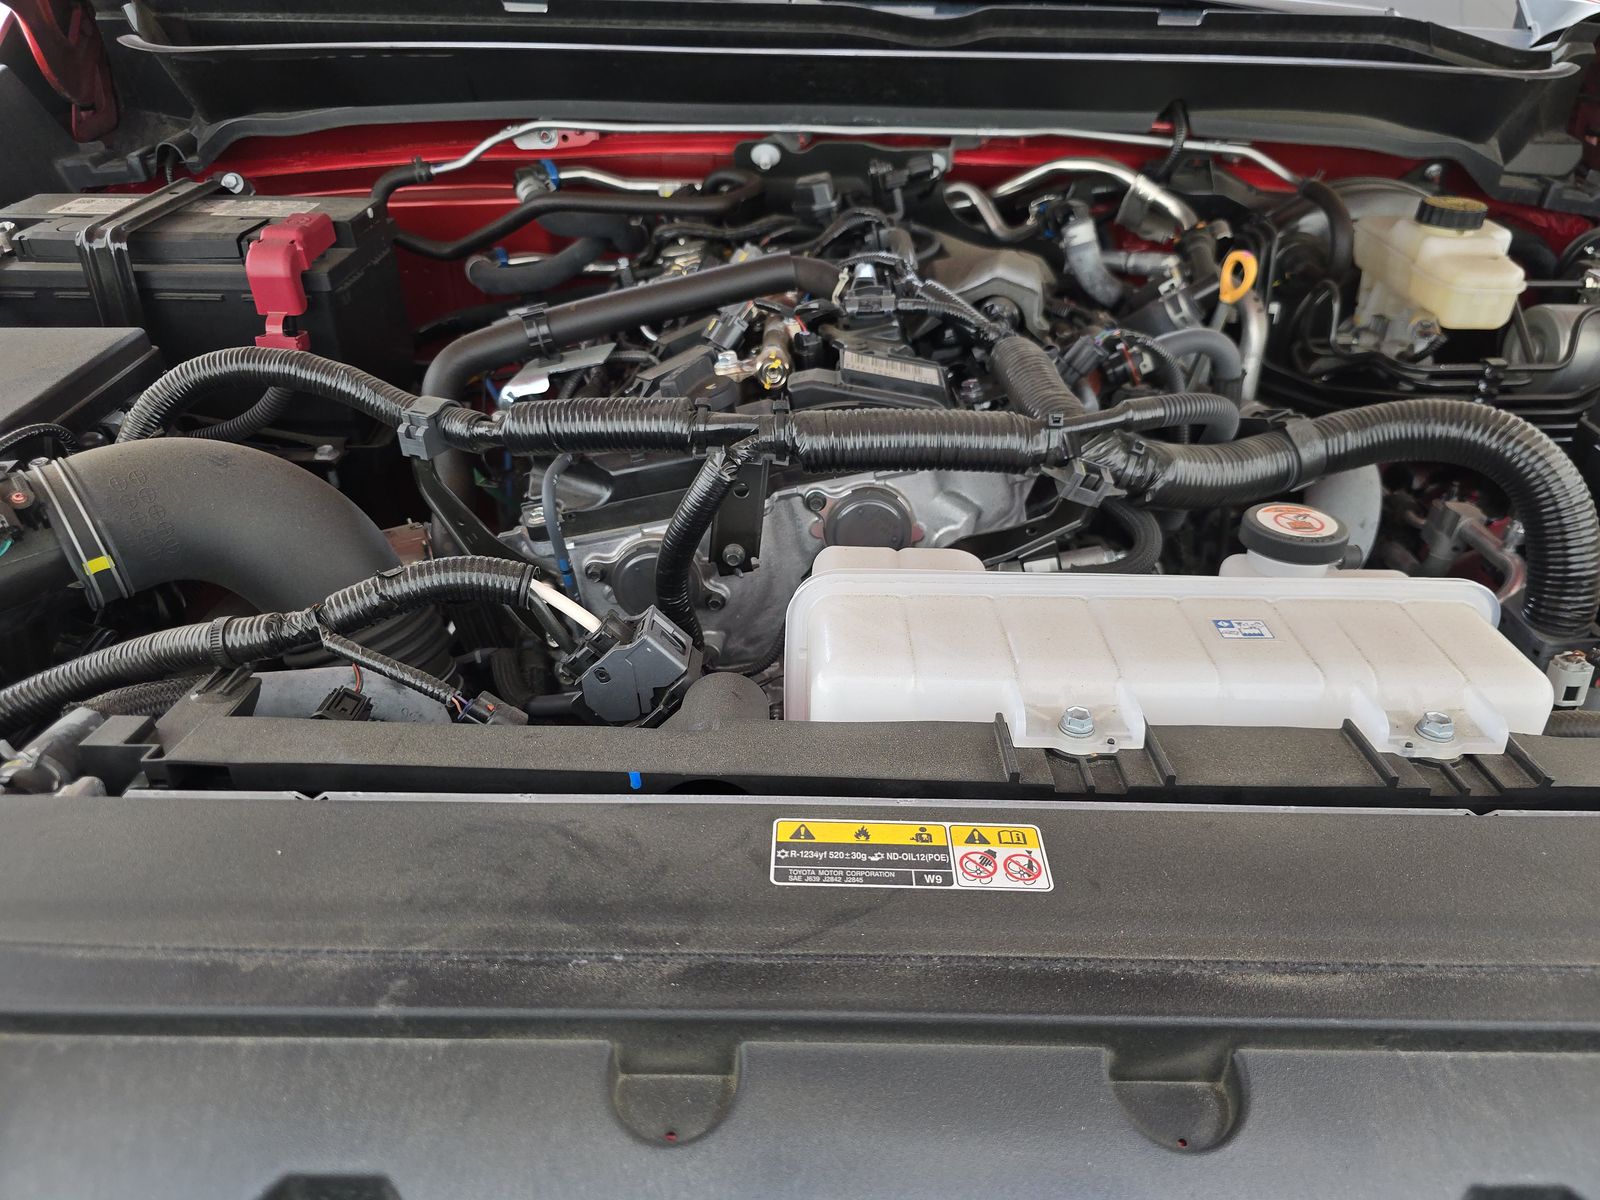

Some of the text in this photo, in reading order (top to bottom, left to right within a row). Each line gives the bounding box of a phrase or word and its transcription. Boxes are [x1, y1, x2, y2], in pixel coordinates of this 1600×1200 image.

[790, 850, 827, 860] R-1234yf
[886, 852, 949, 863] ND-OIL12(POE)
[924, 874, 943, 884] W9
